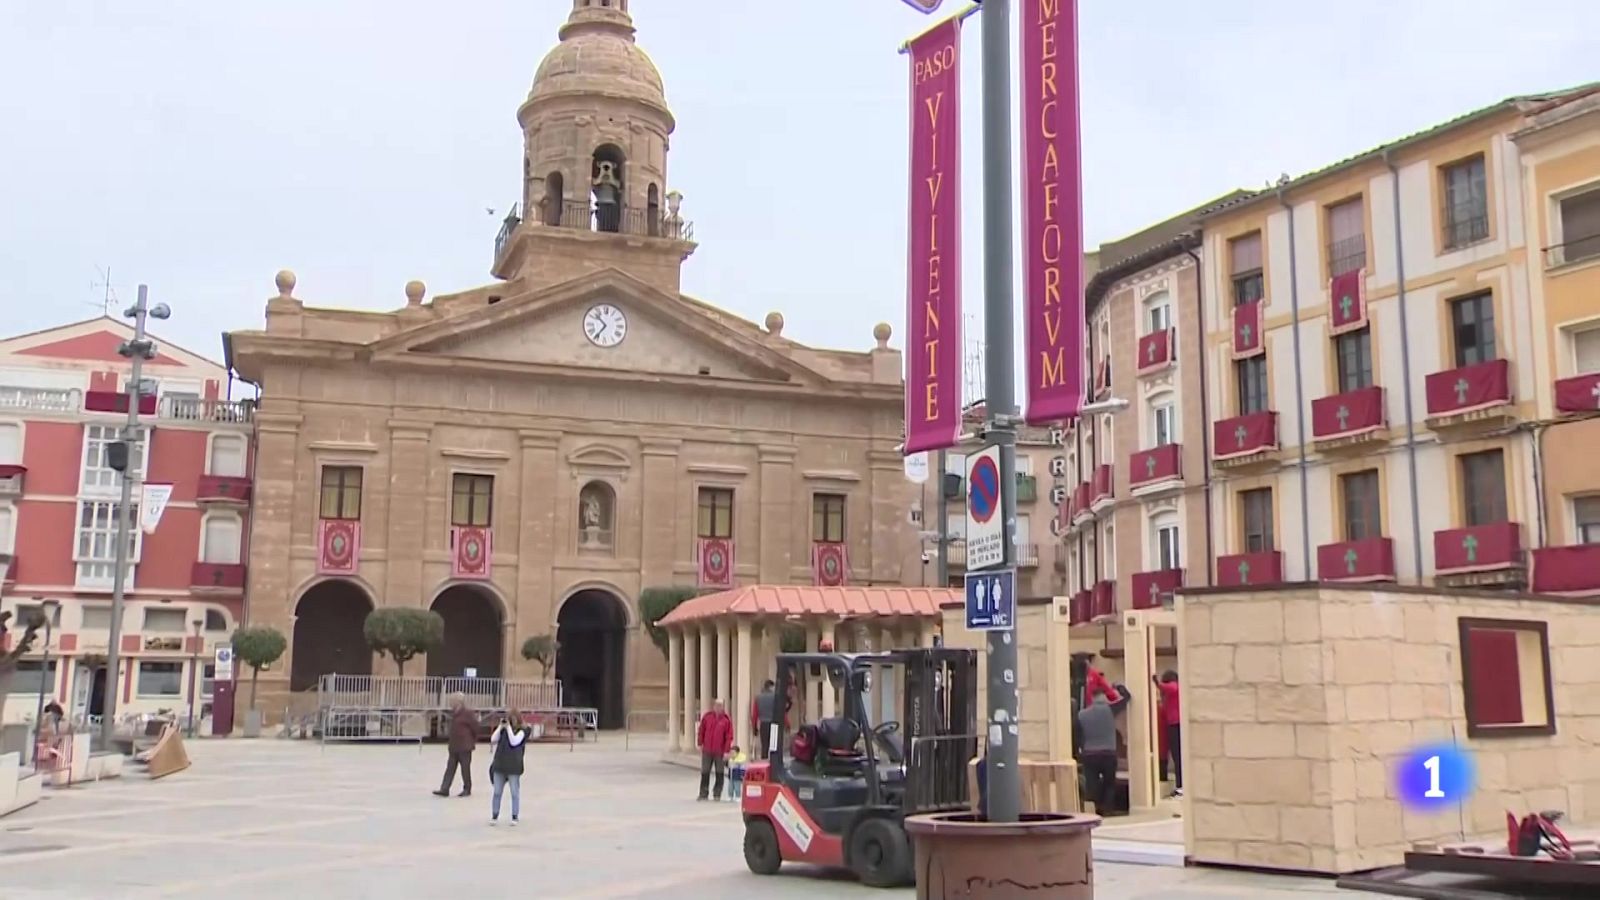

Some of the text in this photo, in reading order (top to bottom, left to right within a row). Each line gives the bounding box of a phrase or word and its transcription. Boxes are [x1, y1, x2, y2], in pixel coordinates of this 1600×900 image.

[915, 45, 955, 86] PASO
[925, 91, 944, 422] VIVIENTE
[1037, 0, 1065, 388] MERCAFORVM
[992, 612, 1008, 625] WC
